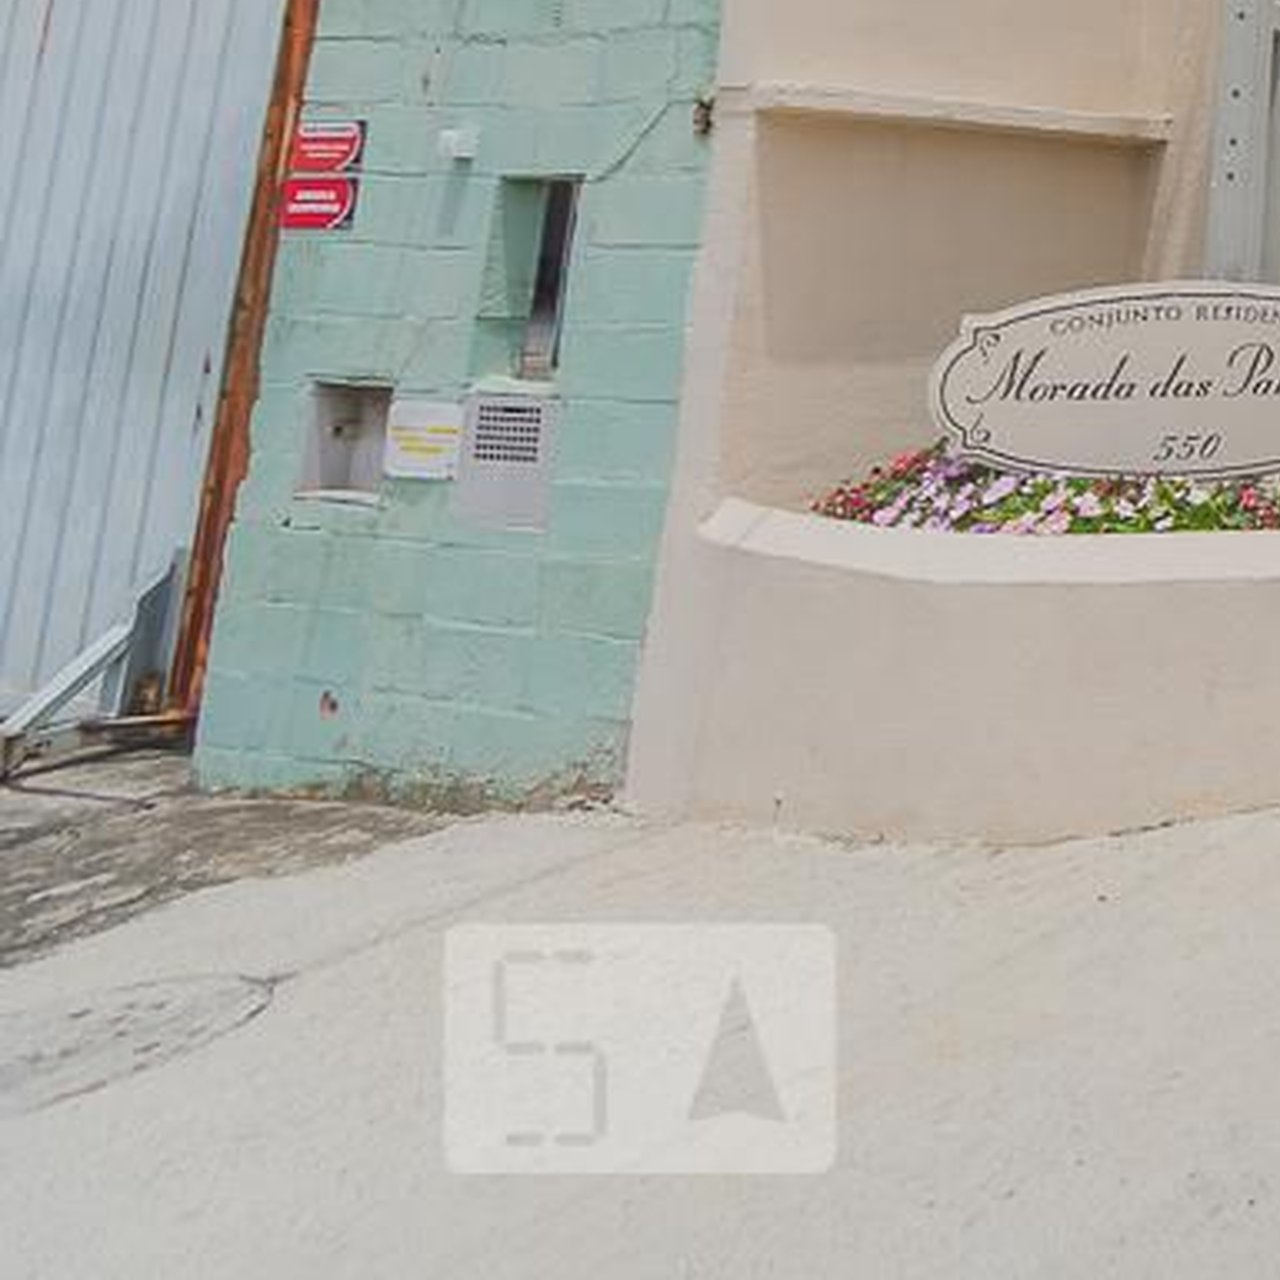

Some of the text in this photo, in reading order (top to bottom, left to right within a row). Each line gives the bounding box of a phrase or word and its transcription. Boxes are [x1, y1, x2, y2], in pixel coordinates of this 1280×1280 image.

[1049, 305, 1182, 335] CONJUNTO
[966, 347, 1138, 405] Morada
[1148, 354, 1213, 399] das
[1153, 433, 1222, 461] 550
